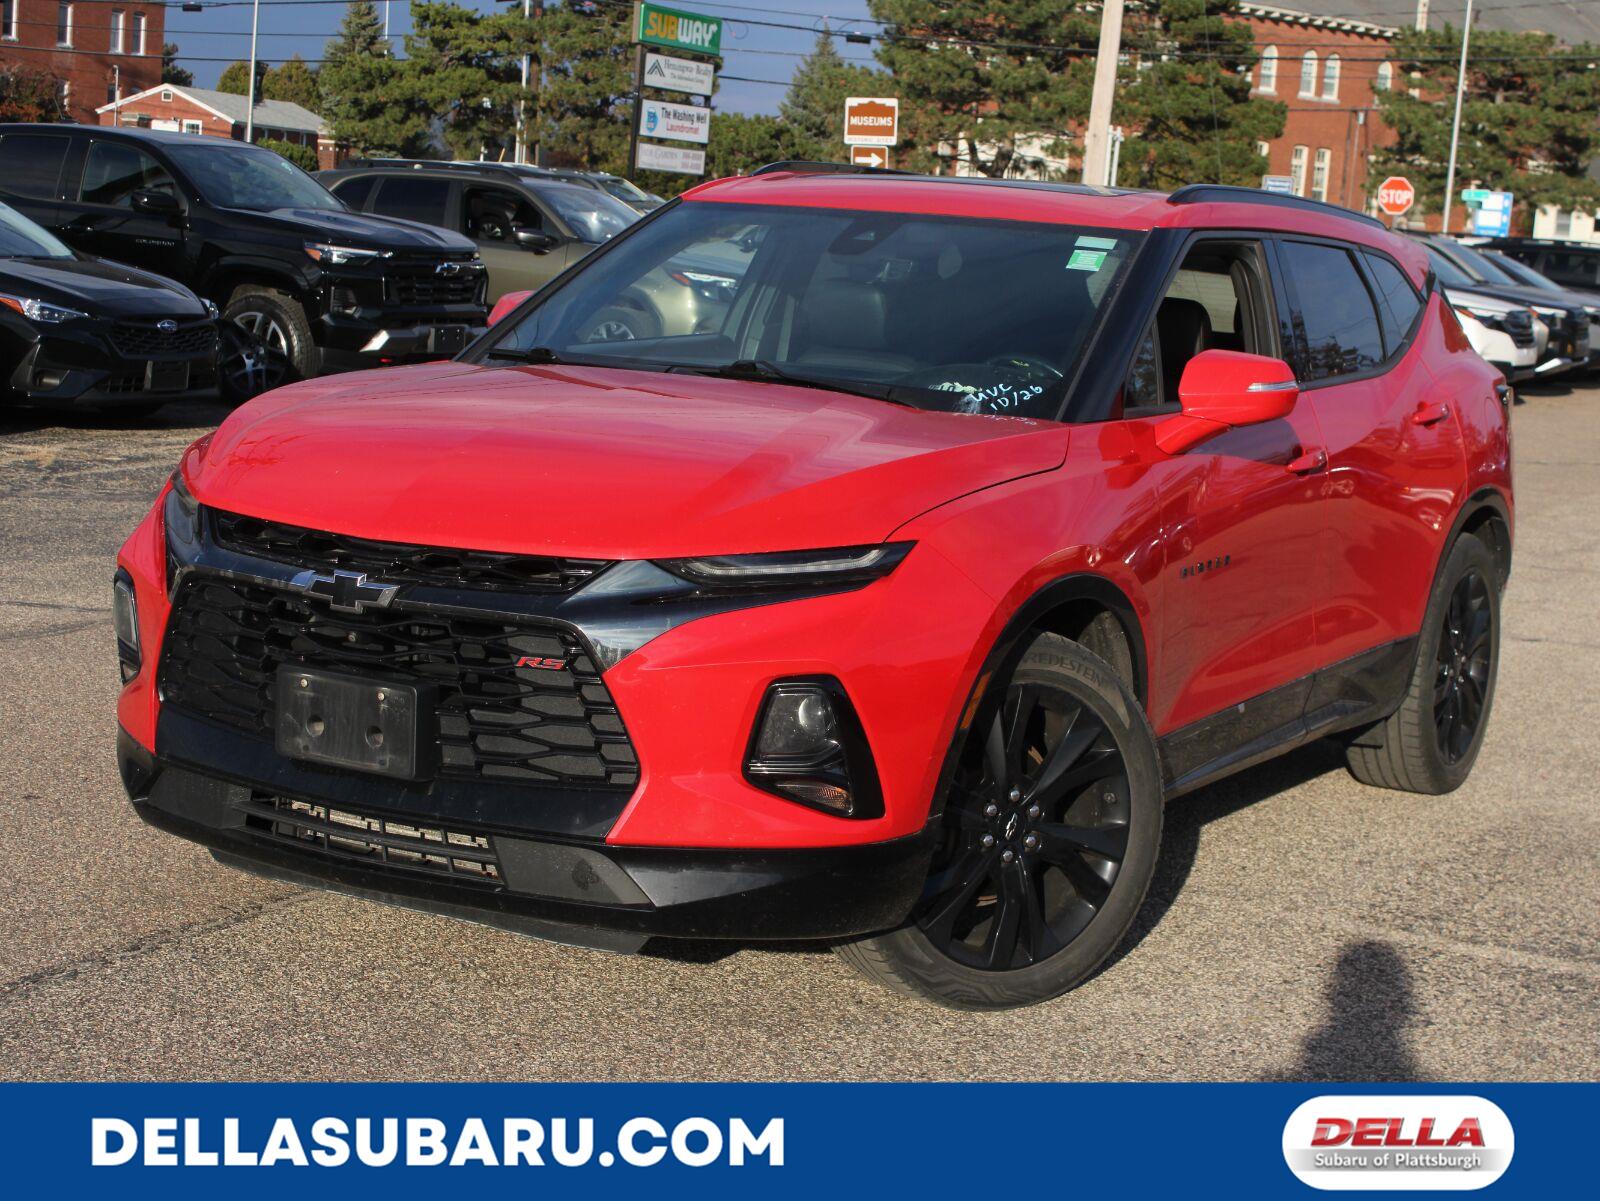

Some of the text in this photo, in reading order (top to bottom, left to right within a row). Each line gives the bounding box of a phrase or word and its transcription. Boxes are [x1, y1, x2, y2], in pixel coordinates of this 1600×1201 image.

[645, 11, 718, 48] SUBWAY
[662, 107, 707, 125] The Washing Well
[850, 115, 893, 127] MUSEUMS
[1380, 188, 1411, 205] STOP
[514, 656, 567, 671] RS
